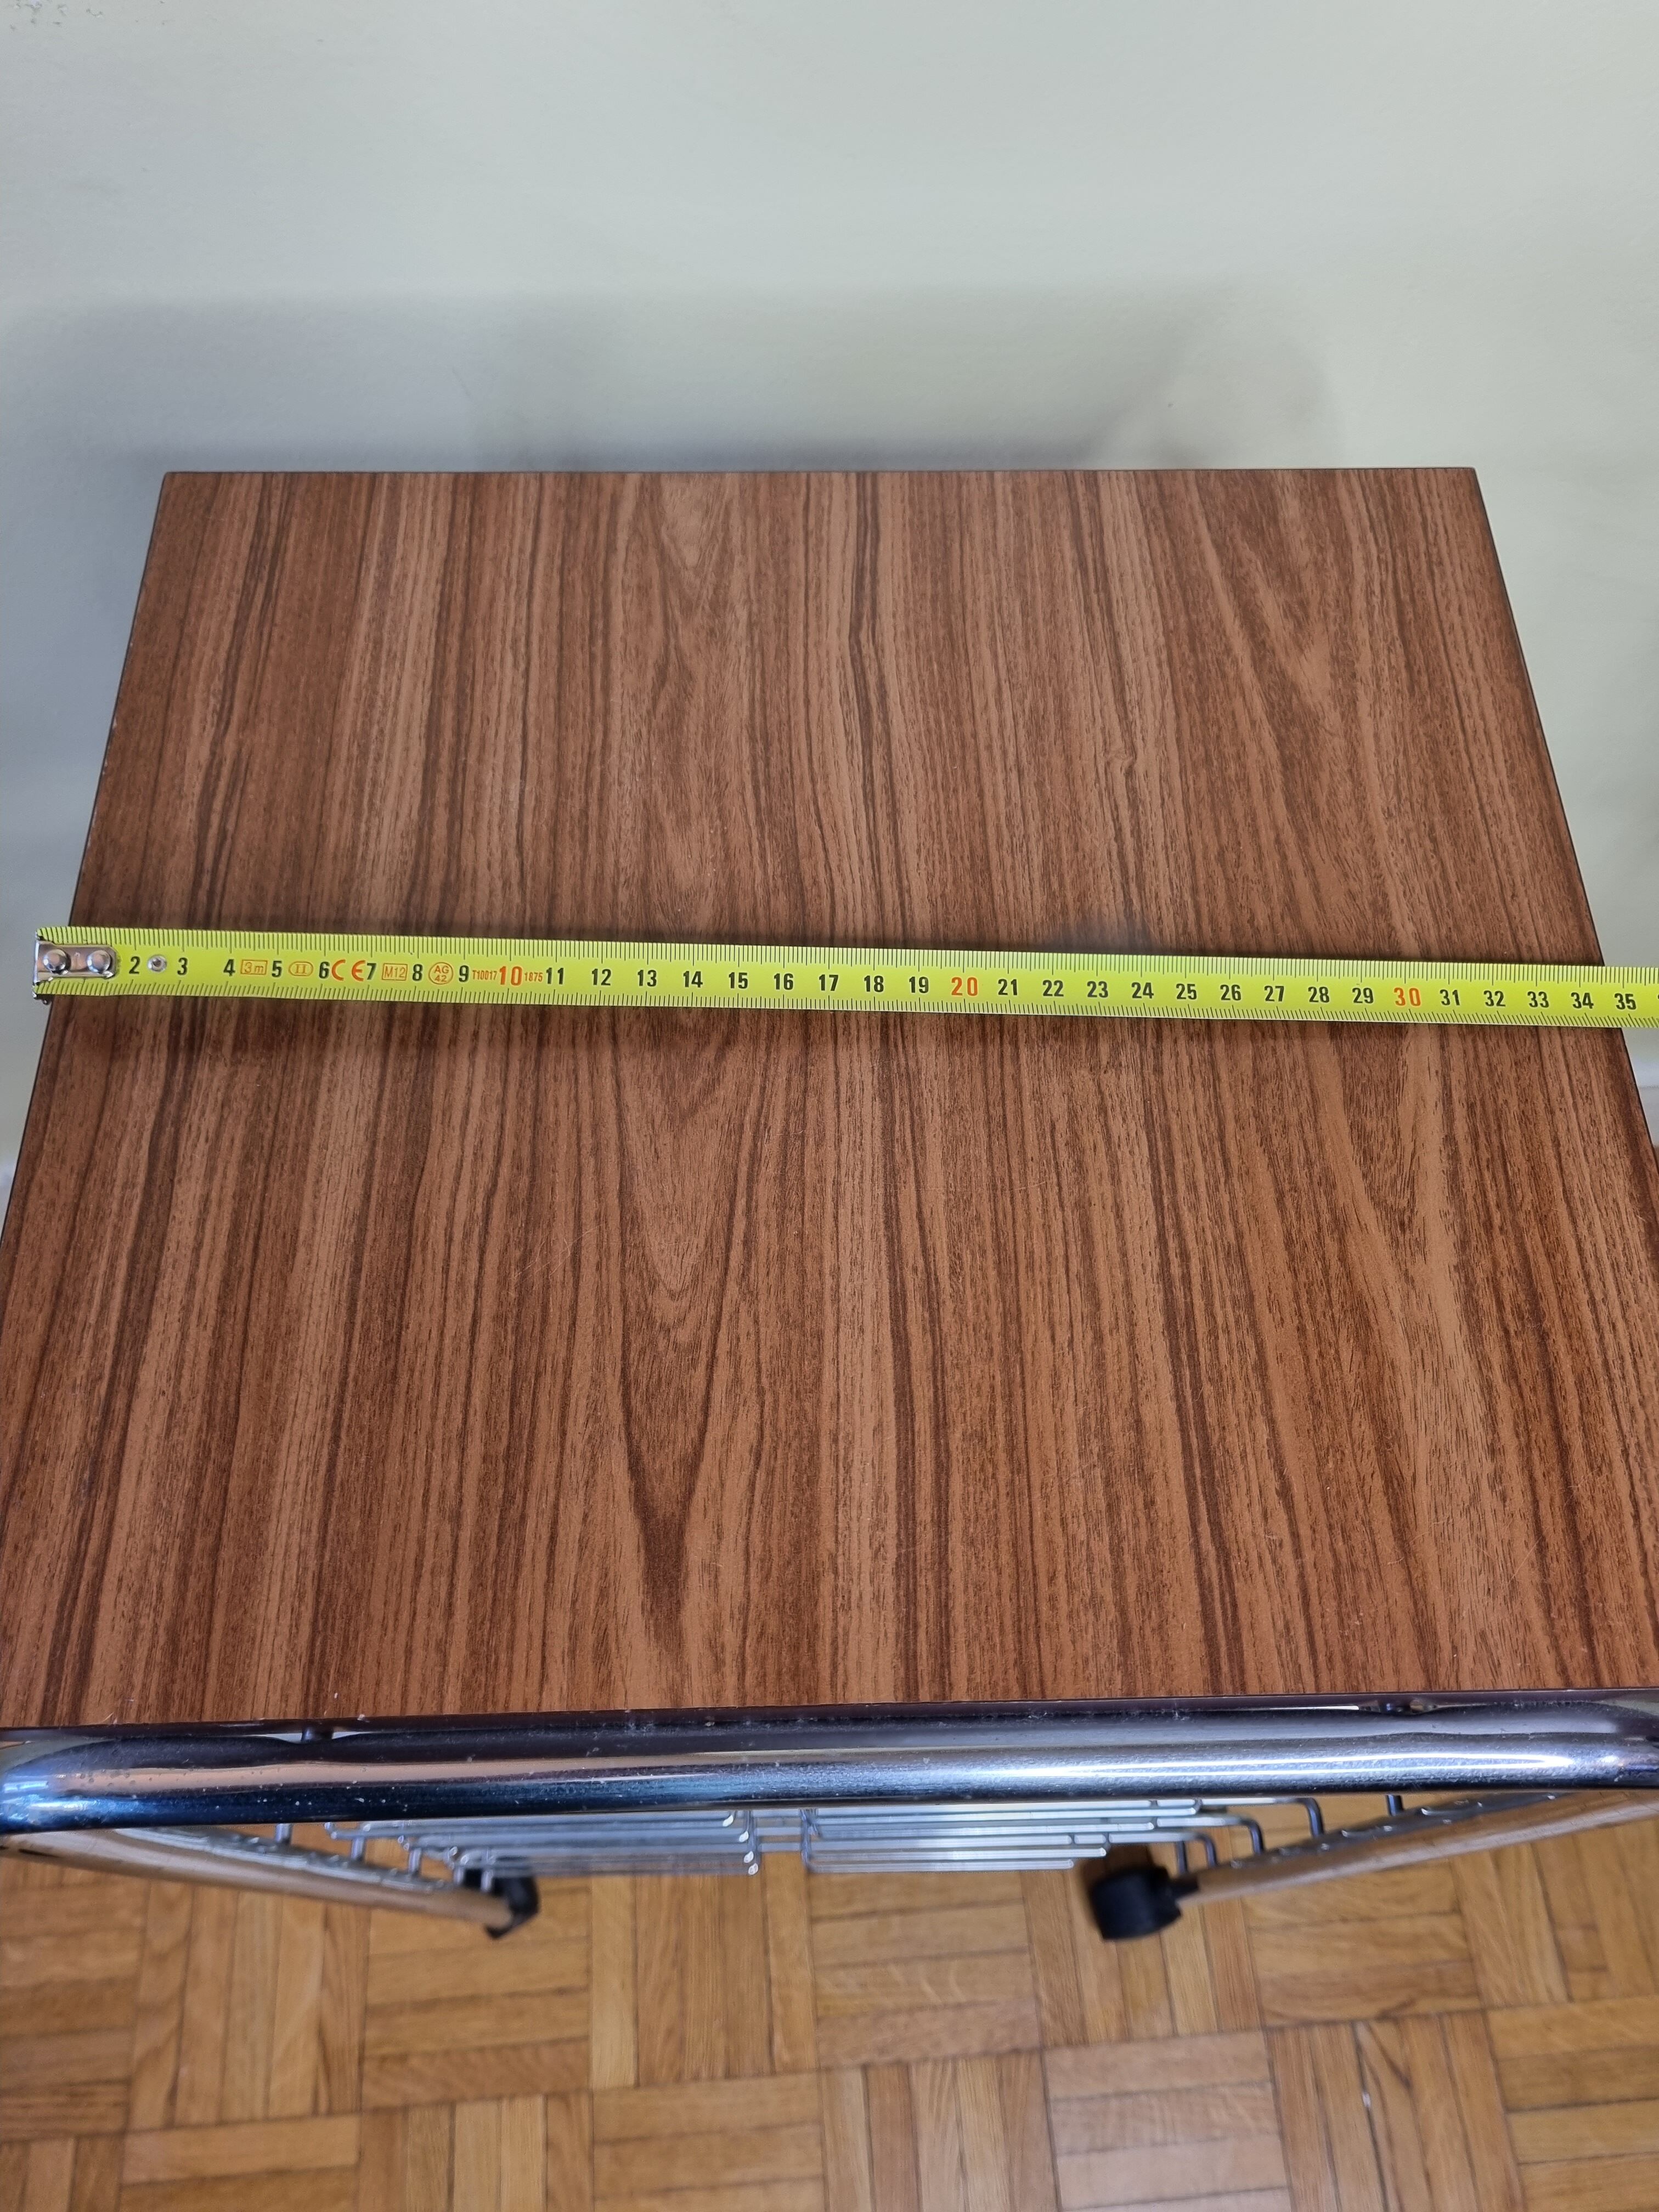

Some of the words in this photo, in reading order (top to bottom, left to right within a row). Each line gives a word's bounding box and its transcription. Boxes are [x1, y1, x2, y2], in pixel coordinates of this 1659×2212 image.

[331, 959, 366, 982] CE
[384, 966, 406, 979] M12
[433, 965, 449, 974] AG
[472, 969, 498, 980] T10017
[524, 972, 543, 982] 1875
[128, 956, 141, 975] 2
[177, 957, 188, 976] 3
[223, 958, 236, 977] 4
[271, 960, 283, 978] 5
[318, 961, 330, 979] 6
[366, 962, 377, 980] 7
[412, 963, 424, 981] 8
[458, 964, 470, 983] 9
[499, 966, 523, 986] 10
[546, 967, 564, 985] 11
[591, 968, 612, 986] 12
[637, 969, 657, 988] 13
[683, 970, 703, 988] 14
[728, 972, 748, 989] 15
[774, 973, 794, 991] 16
[819, 974, 839, 992] 17
[864, 975, 884, 993] 18
[909, 976, 929, 994] 19
[951, 977, 978, 996] 20
[997, 978, 1018, 996] 21
[1042, 979, 1064, 997] 22
[1087, 980, 1109, 998] 23
[1131, 981, 1154, 999] 24
[1176, 983, 1197, 1000] 25
[1220, 984, 1242, 1001] 26
[1264, 985, 1284, 1002] 27
[1307, 986, 1330, 1003] 28
[1352, 987, 1374, 1004] 29
[1393, 987, 1421, 1007] 30
[1439, 989, 1460, 1006] 31
[1483, 990, 1506, 1007] 32
[1527, 991, 1549, 1008] 33
[1571, 992, 1594, 1009] 34
[1614, 992, 1637, 1011] 35
